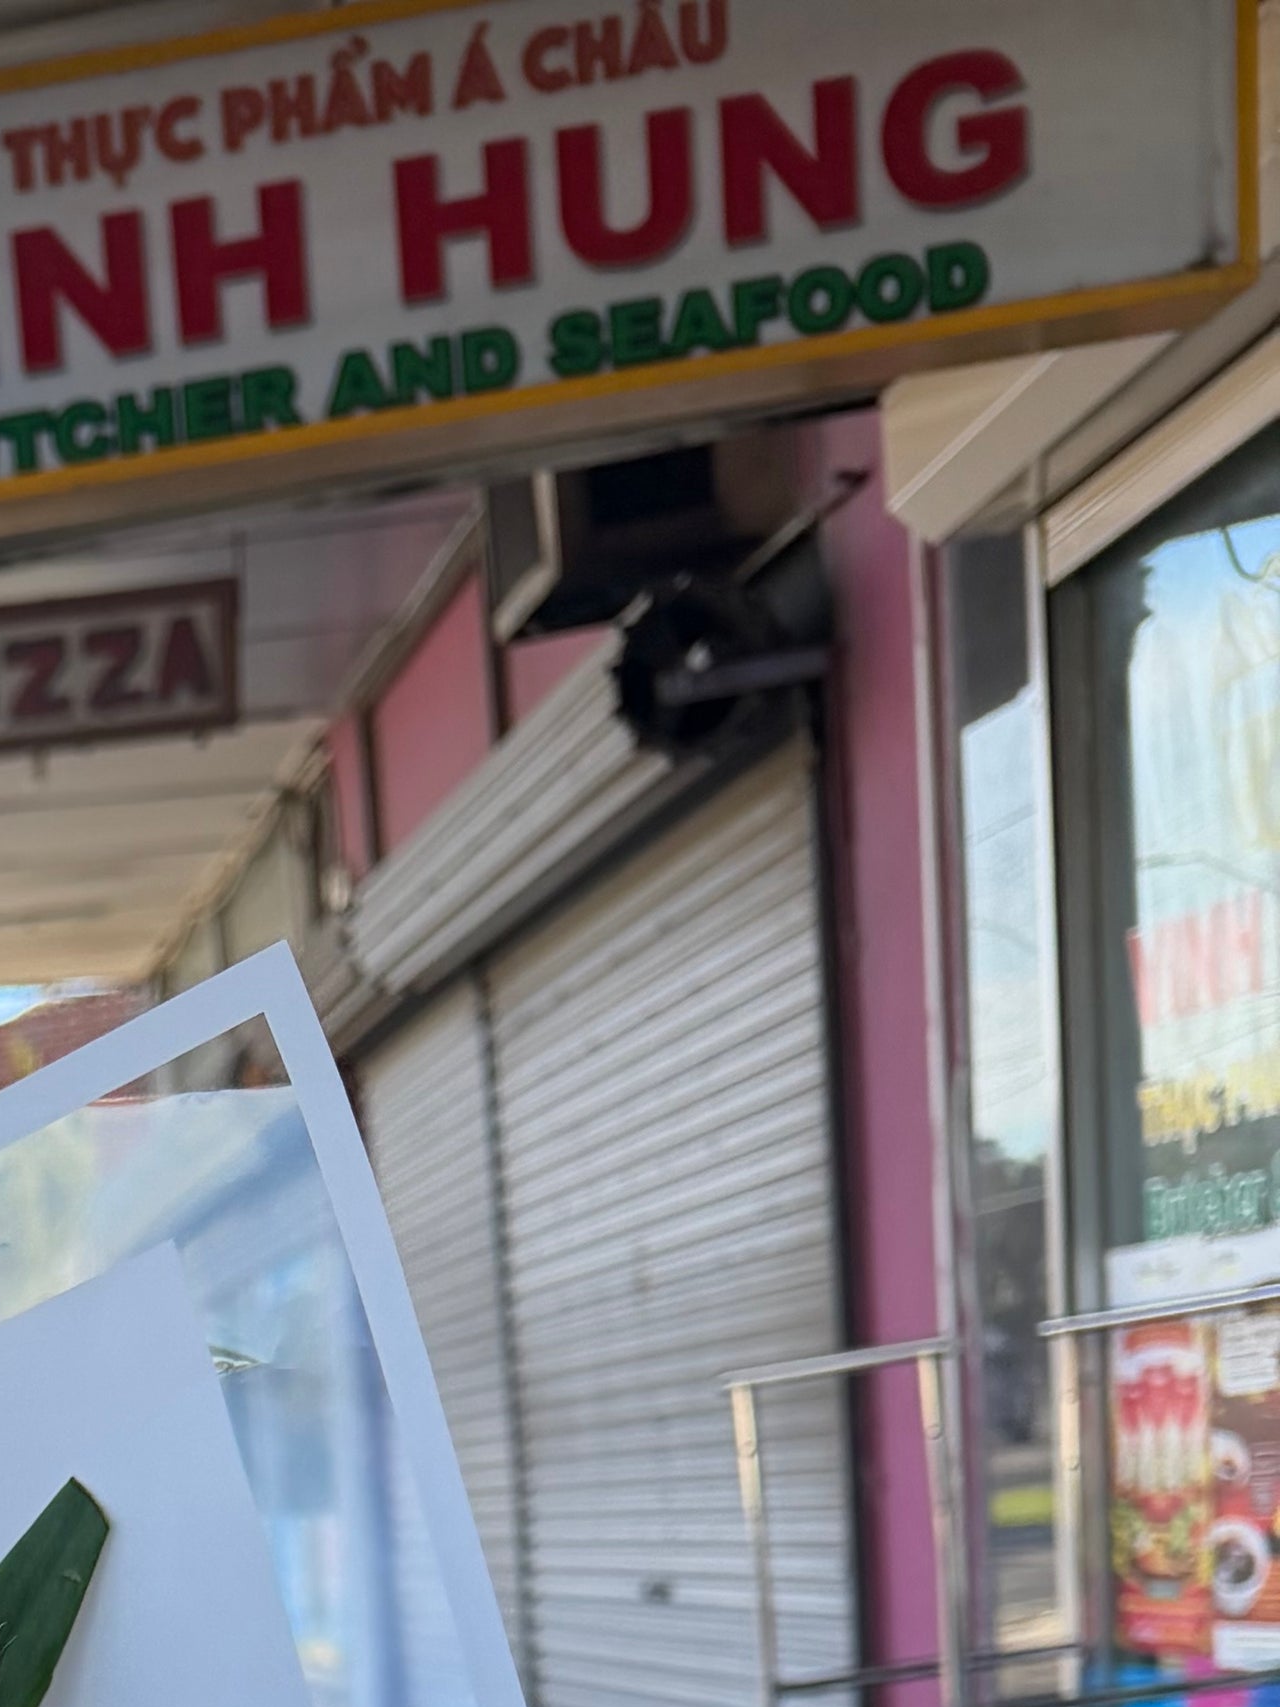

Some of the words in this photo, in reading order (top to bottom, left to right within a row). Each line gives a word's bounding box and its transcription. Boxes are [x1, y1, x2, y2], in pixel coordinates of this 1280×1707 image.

[450, 20, 507, 110] Á
[392, 48, 1030, 308] HUNG
[326, 327, 520, 419] AND
[548, 241, 989, 378] SEAFOOD
